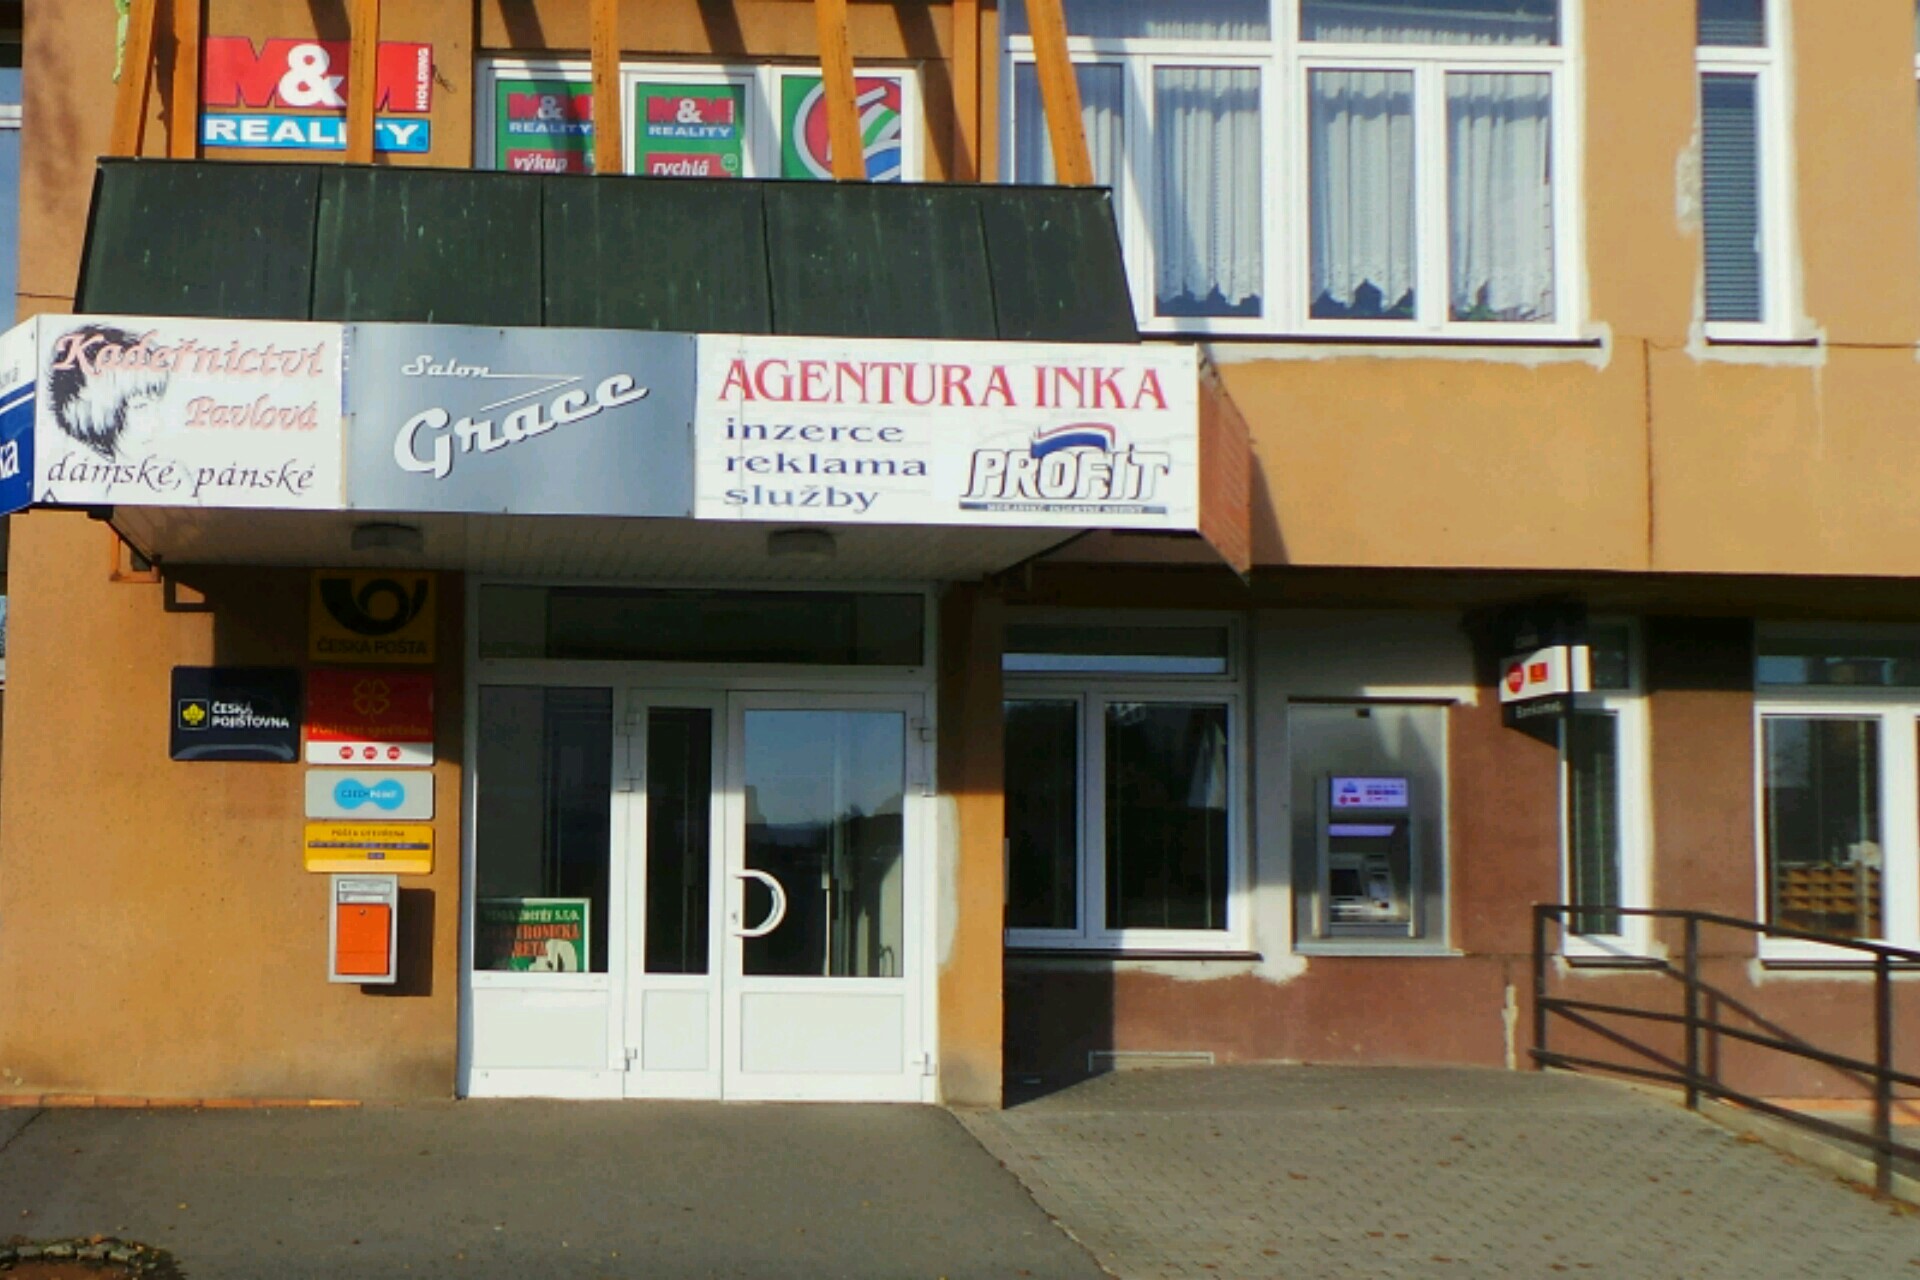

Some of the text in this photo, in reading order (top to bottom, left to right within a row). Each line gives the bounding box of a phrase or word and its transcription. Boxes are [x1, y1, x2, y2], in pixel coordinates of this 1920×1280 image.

[415, 47, 432, 111] HOLDING
[648, 96, 732, 124] M&M
[205, 118, 419, 146] REALIY
[508, 121, 592, 134] REALITY
[648, 126, 731, 138] REALITY
[514, 152, 568, 173] výkup
[652, 158, 710, 176] rychlá
[53, 329, 326, 378] Kadeřnictví
[401, 354, 490, 377] Salon
[717, 357, 1169, 410] AGENTURA INKA
[184, 394, 319, 433] Pavlová
[394, 373, 651, 480] Grace
[724, 417, 906, 443] inzerce
[47, 451, 315, 498] dámské, pánské
[724, 452, 929, 477] reklama
[960, 443, 1171, 501] PROFIT
[722, 484, 880, 514] služby
[211, 700, 253, 714] ČESKÁ
